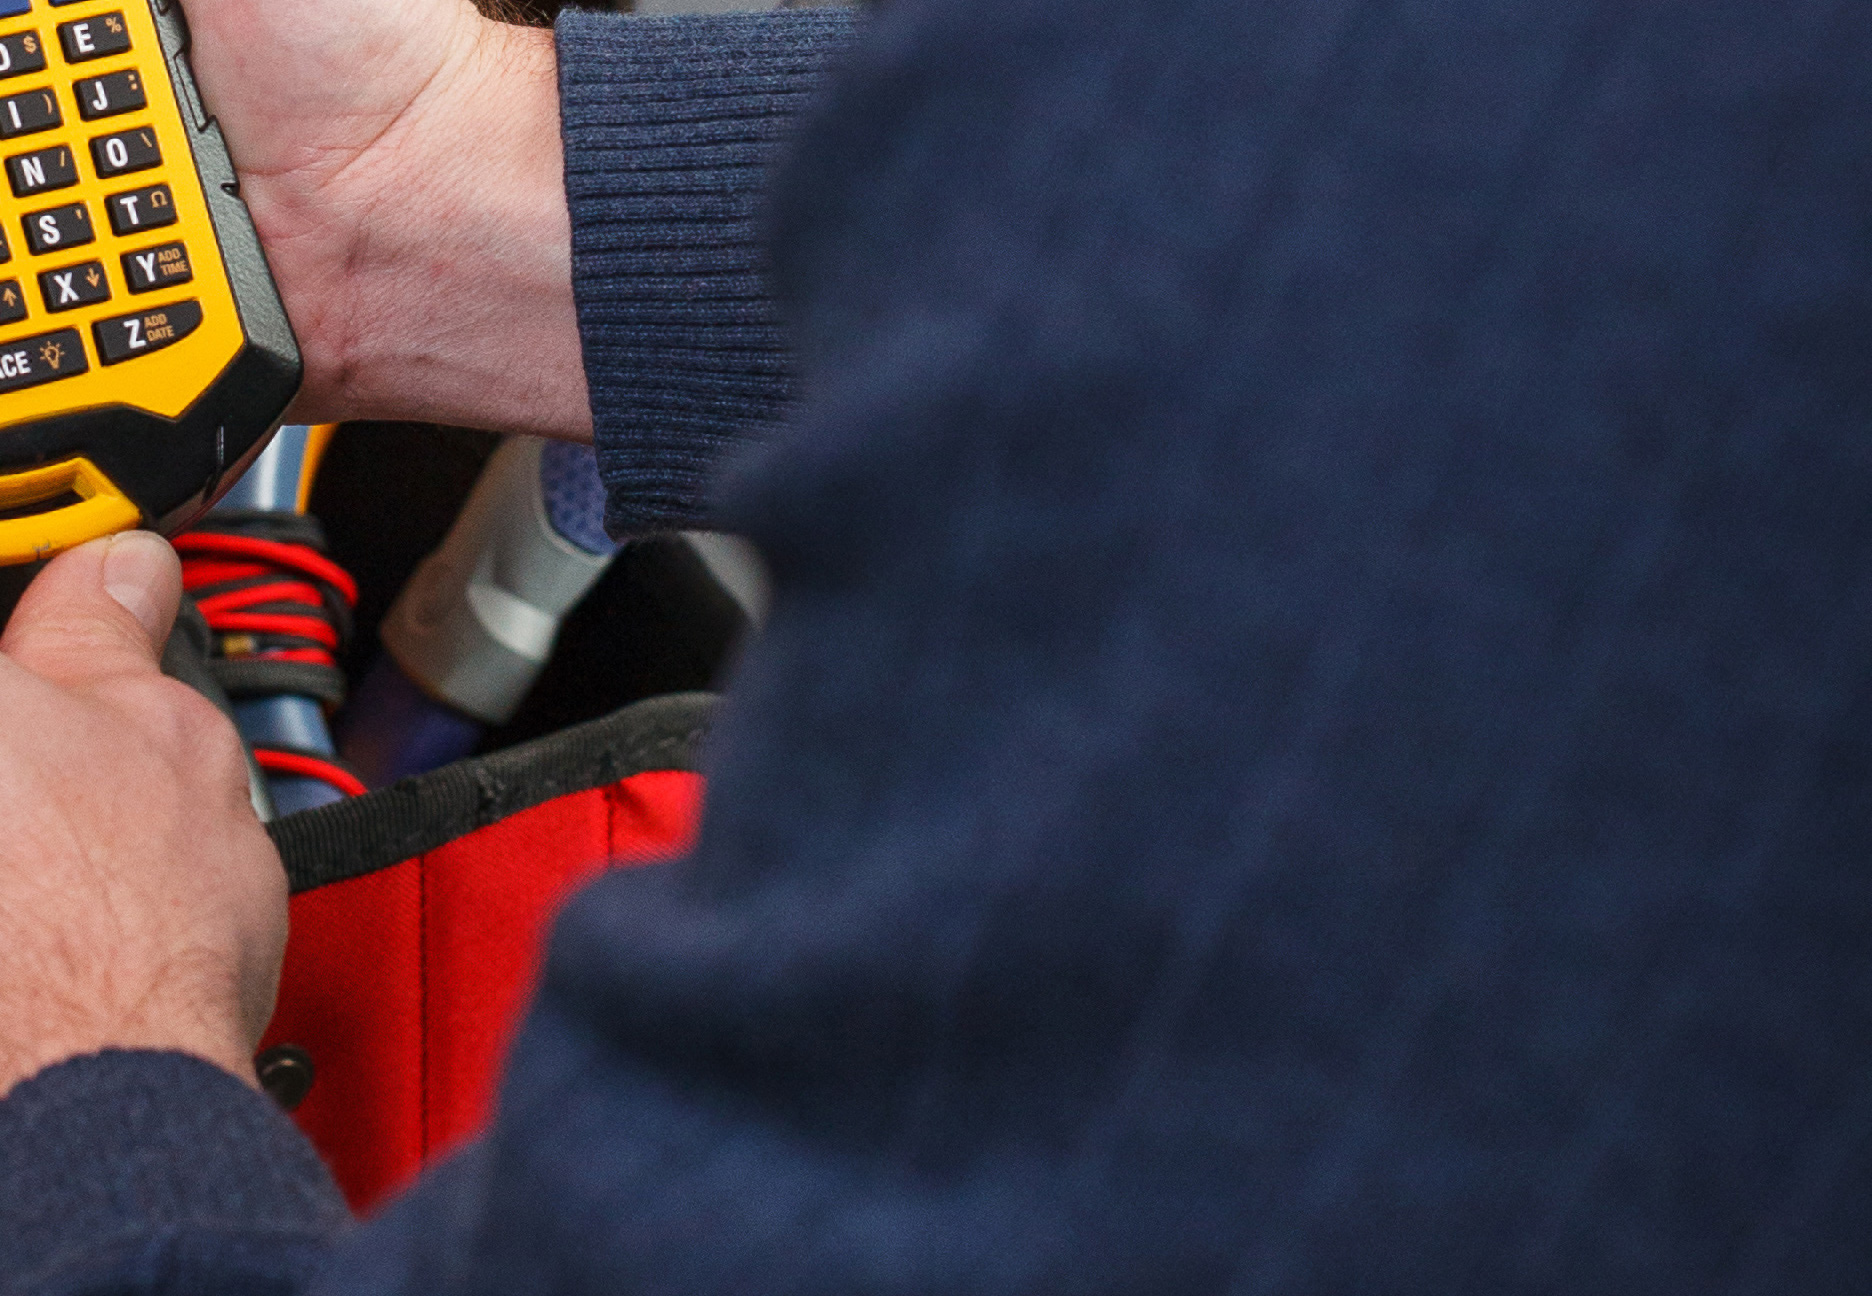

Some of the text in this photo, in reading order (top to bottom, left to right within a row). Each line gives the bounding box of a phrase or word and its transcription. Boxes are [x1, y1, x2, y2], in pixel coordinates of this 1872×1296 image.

[72, 22, 96, 53] E
[92, 80, 108, 111] J
[7, 100, 22, 129] I
[105, 138, 129, 168] O
[20, 156, 46, 187] N
[119, 195, 139, 225] T
[39, 215, 61, 245] S
[135, 248, 180, 283] Y ADD
[160, 260, 188, 276] TIME
[53, 272, 79, 304] X
[123, 313, 167, 349] Z ADD
[146, 325, 174, 342] DATE
